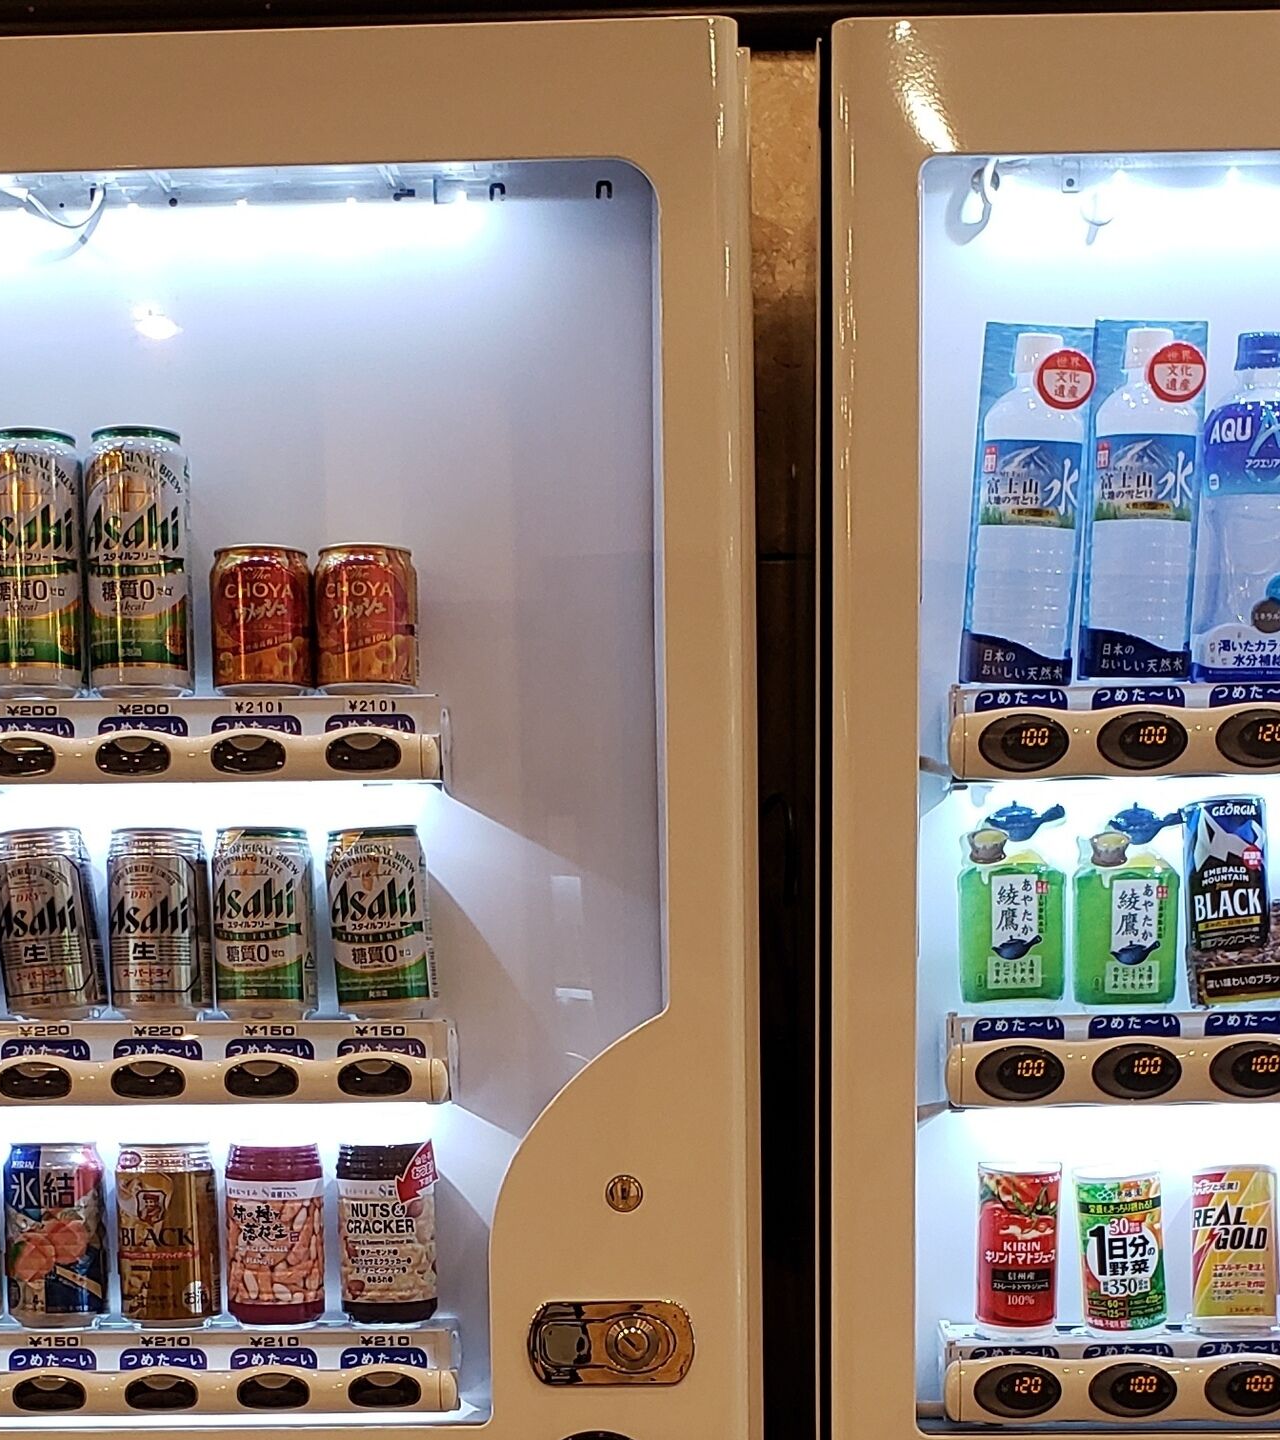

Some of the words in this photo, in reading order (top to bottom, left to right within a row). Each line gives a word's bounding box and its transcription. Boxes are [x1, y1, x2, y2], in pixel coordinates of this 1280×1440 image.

[987, 478, 1039, 495] 富士山
[1044, 458, 1079, 515] 水
[1100, 472, 1152, 490] 富士山
[1158, 450, 1193, 508] 水
[90, 506, 179, 552] Asahi
[226, 582, 294, 599] CHOYA
[325, 581, 393, 599] CHOYA
[984, 649, 1015, 663] 日本の
[1102, 643, 1134, 656] 日本の
[1100, 657, 1184, 674] おいしい天然水
[7, 706, 57, 717] ¥200
[1020, 729, 1048, 746] 100
[1139, 726, 1167, 744] 100
[214, 878, 294, 922] Asahi
[331, 879, 417, 923] Asahi
[997, 885, 1019, 933] 綾鷹
[1021, 880, 1033, 935] あやたか
[1194, 889, 1262, 920] BLACK
[113, 898, 189, 935] Asahi
[350, 920, 396, 930] スタイルフリー
[132, 942, 157, 962] 生
[226, 945, 269, 963] 糖質0
[352, 945, 398, 963] 糖質0
[20, 1026, 70, 1037] ¥220
[245, 1026, 295, 1036] ¥150
[355, 1025, 405, 1036] ¥150
[1016, 1060, 1044, 1077] 100
[1251, 1055, 1280, 1073] 100
[11, 1173, 75, 1209] 氷結
[1193, 1201, 1247, 1228] REAL
[347, 1219, 414, 1234] CRACKER
[121, 1228, 194, 1247] BLACK
[1003, 1242, 1041, 1251] KIRIN
[1214, 1227, 1268, 1250] GOLD
[985, 1250, 1056, 1264] キリントマトジュース
[1109, 1259, 1149, 1276] 野菜
[1109, 1278, 1136, 1296] 350
[1008, 1294, 1034, 1305] 100%
[30, 1336, 79, 1347] ¥150
[141, 1336, 191, 1347] ¥210
[1014, 1376, 1042, 1394] 120
